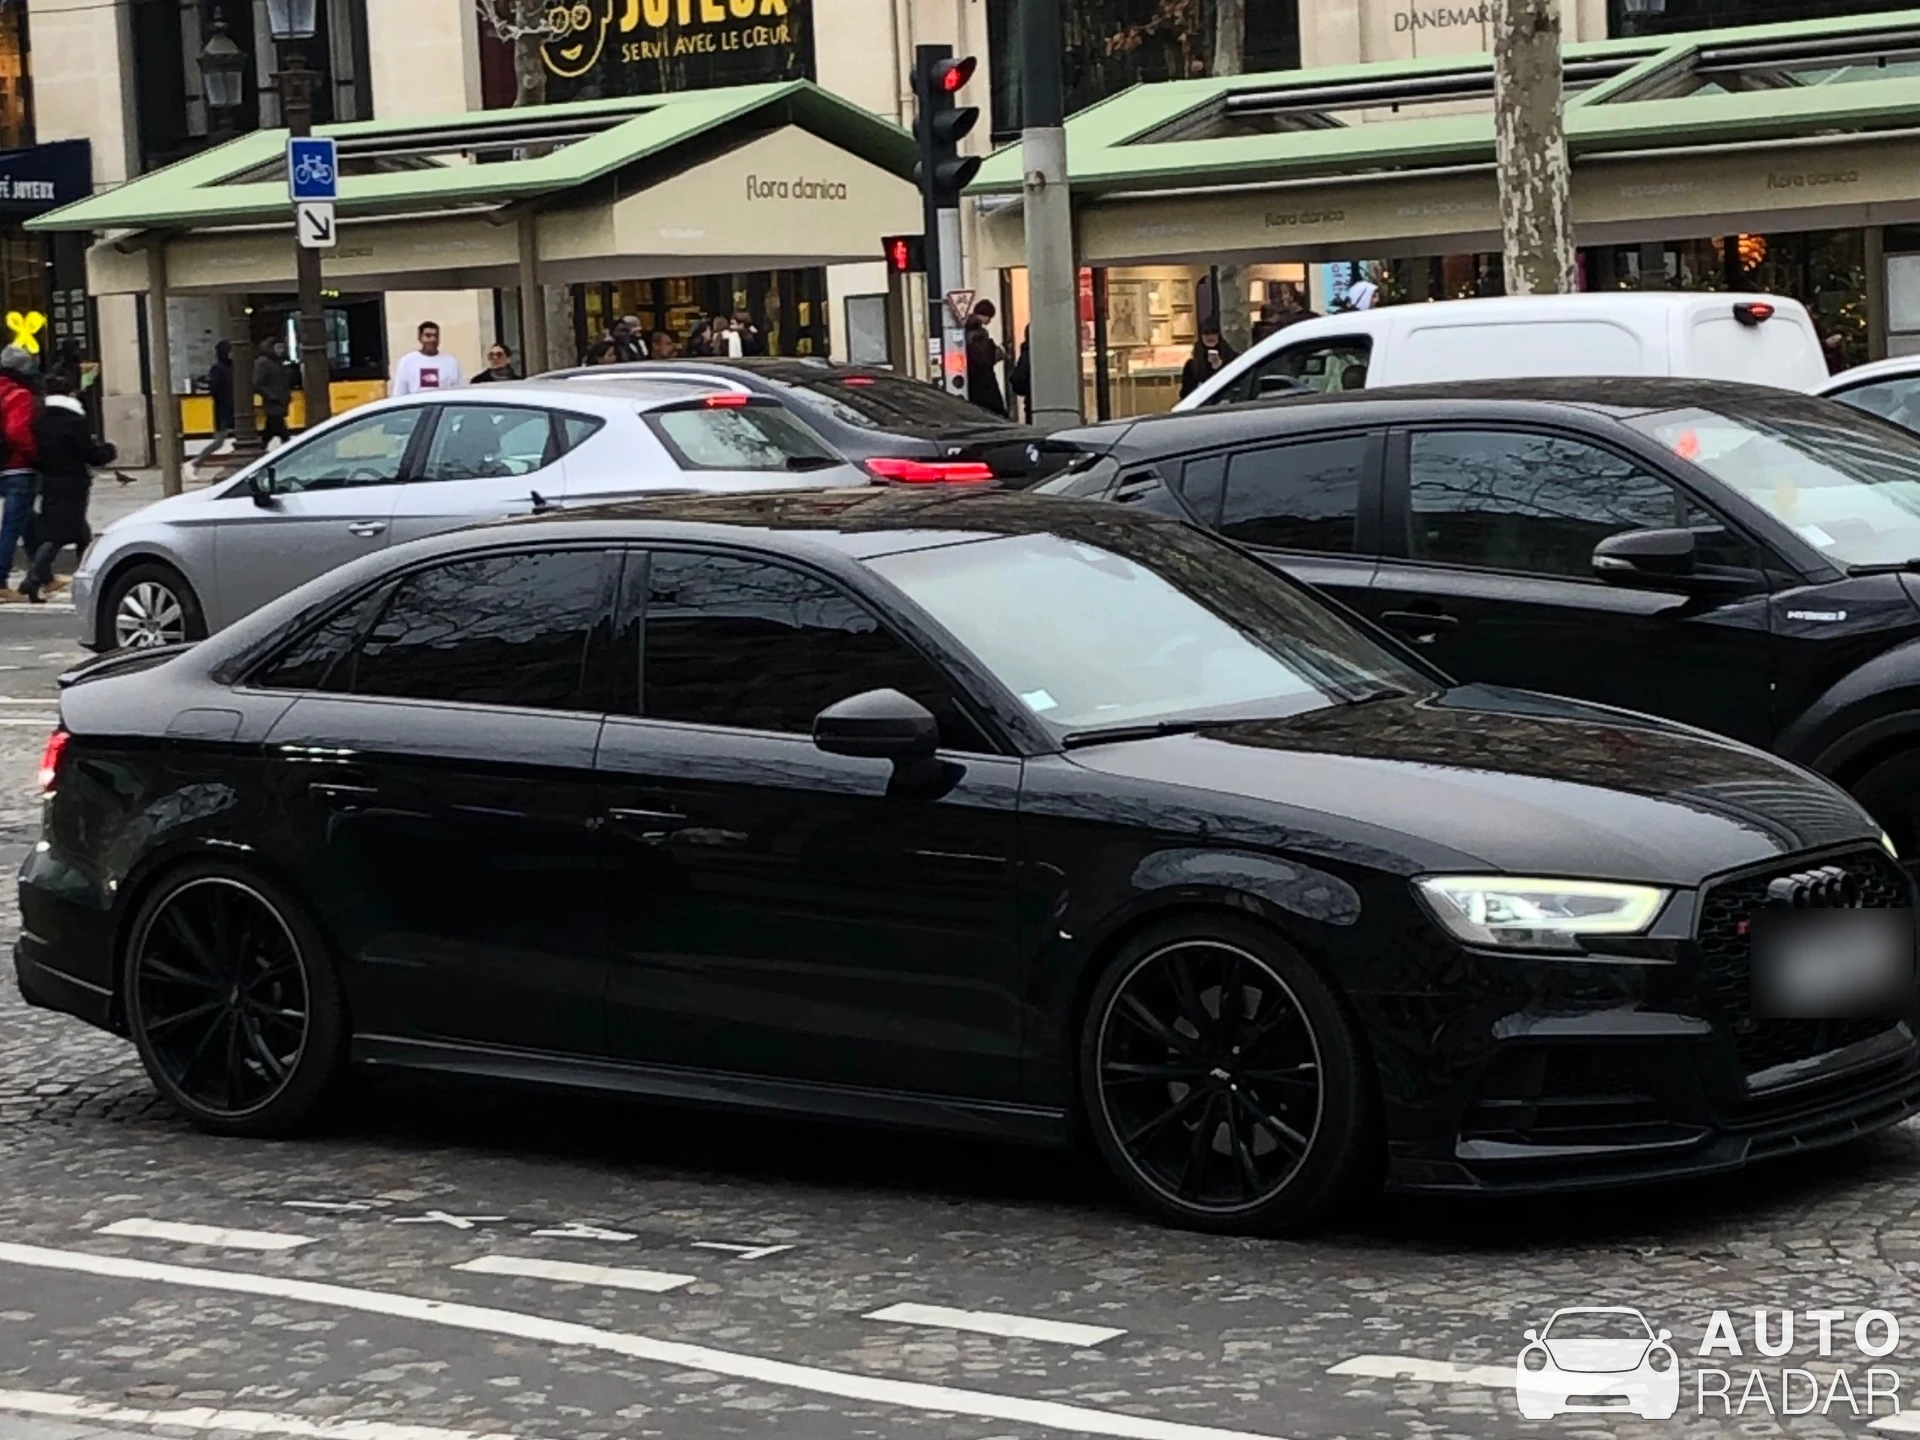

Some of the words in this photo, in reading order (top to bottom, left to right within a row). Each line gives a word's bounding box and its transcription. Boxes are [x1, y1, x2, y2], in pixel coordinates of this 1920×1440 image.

[621, 40, 669, 64] SERVI
[673, 33, 716, 57] AVEC
[721, 31, 739, 50] LE
[743, 25, 792, 48] CŒUR
[746, 174, 788, 201] flora
[792, 176, 846, 201] danica
